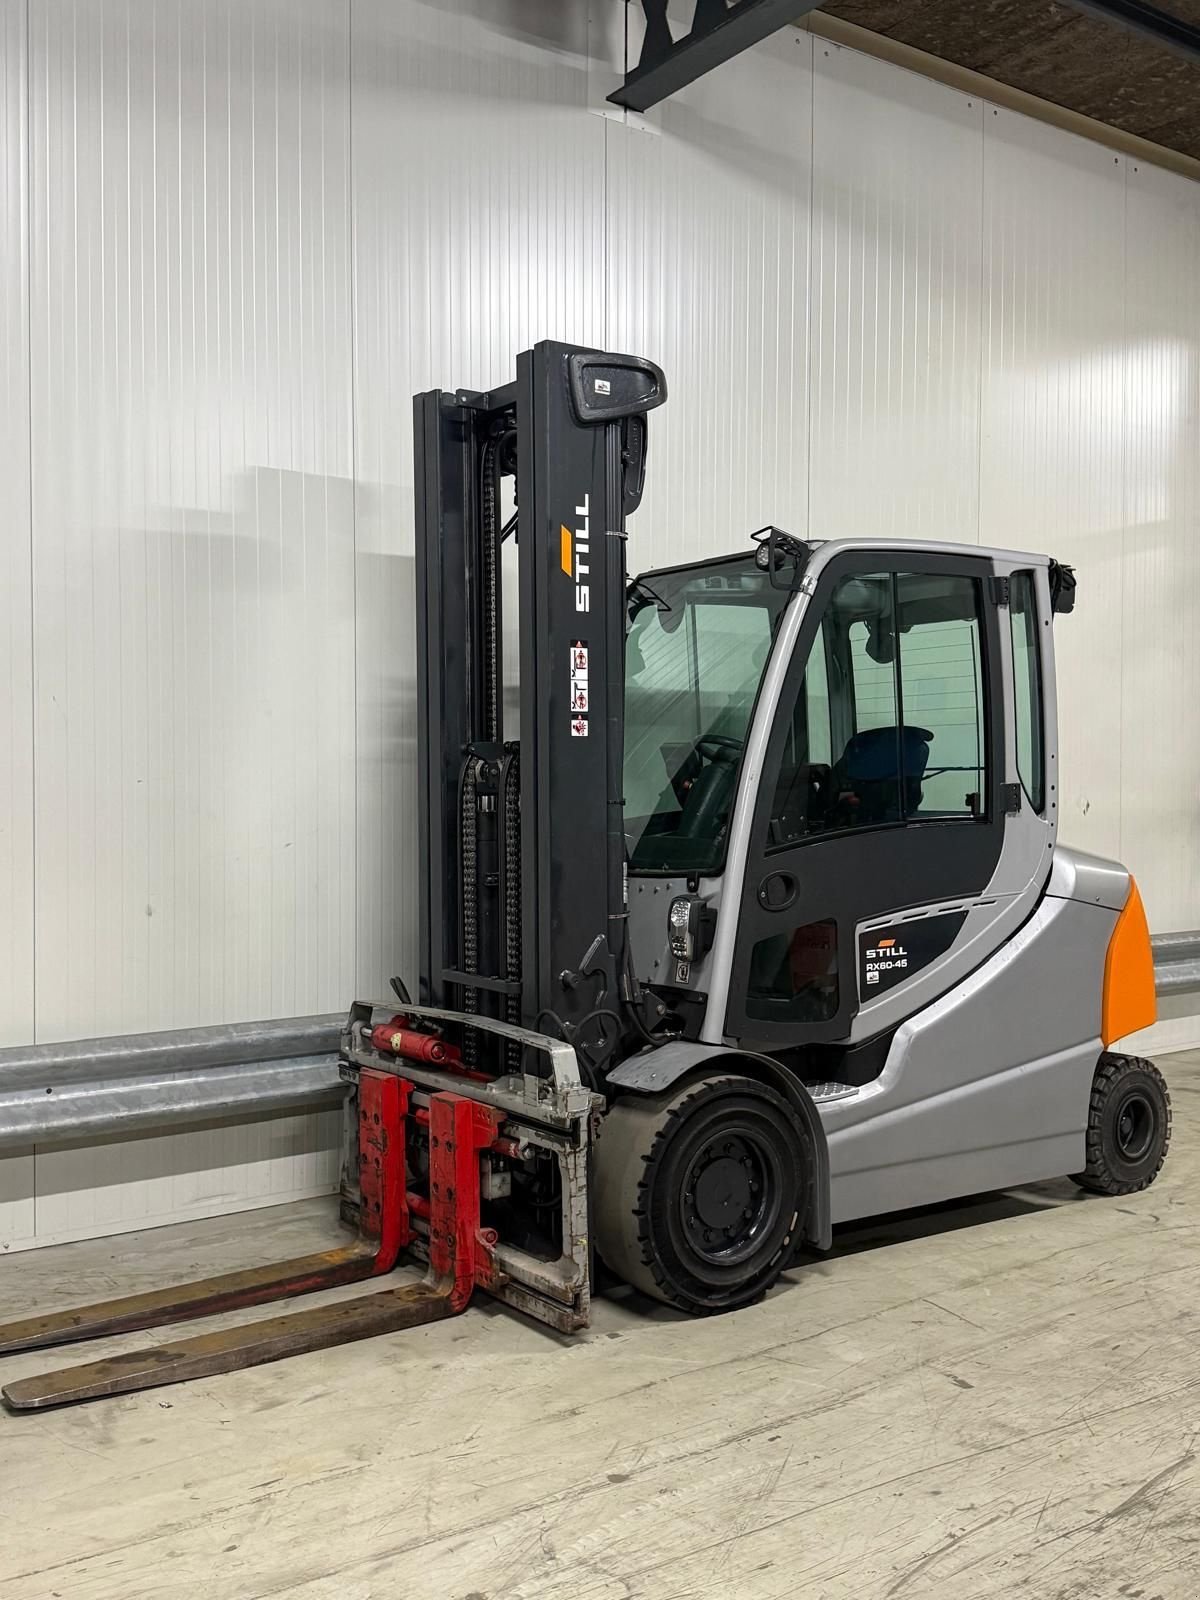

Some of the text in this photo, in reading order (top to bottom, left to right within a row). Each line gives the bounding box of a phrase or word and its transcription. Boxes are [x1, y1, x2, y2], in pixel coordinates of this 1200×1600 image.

[575, 493, 590, 613] STILL
[866, 946, 908, 959] STILL
[866, 959, 908, 972] RX60-45
